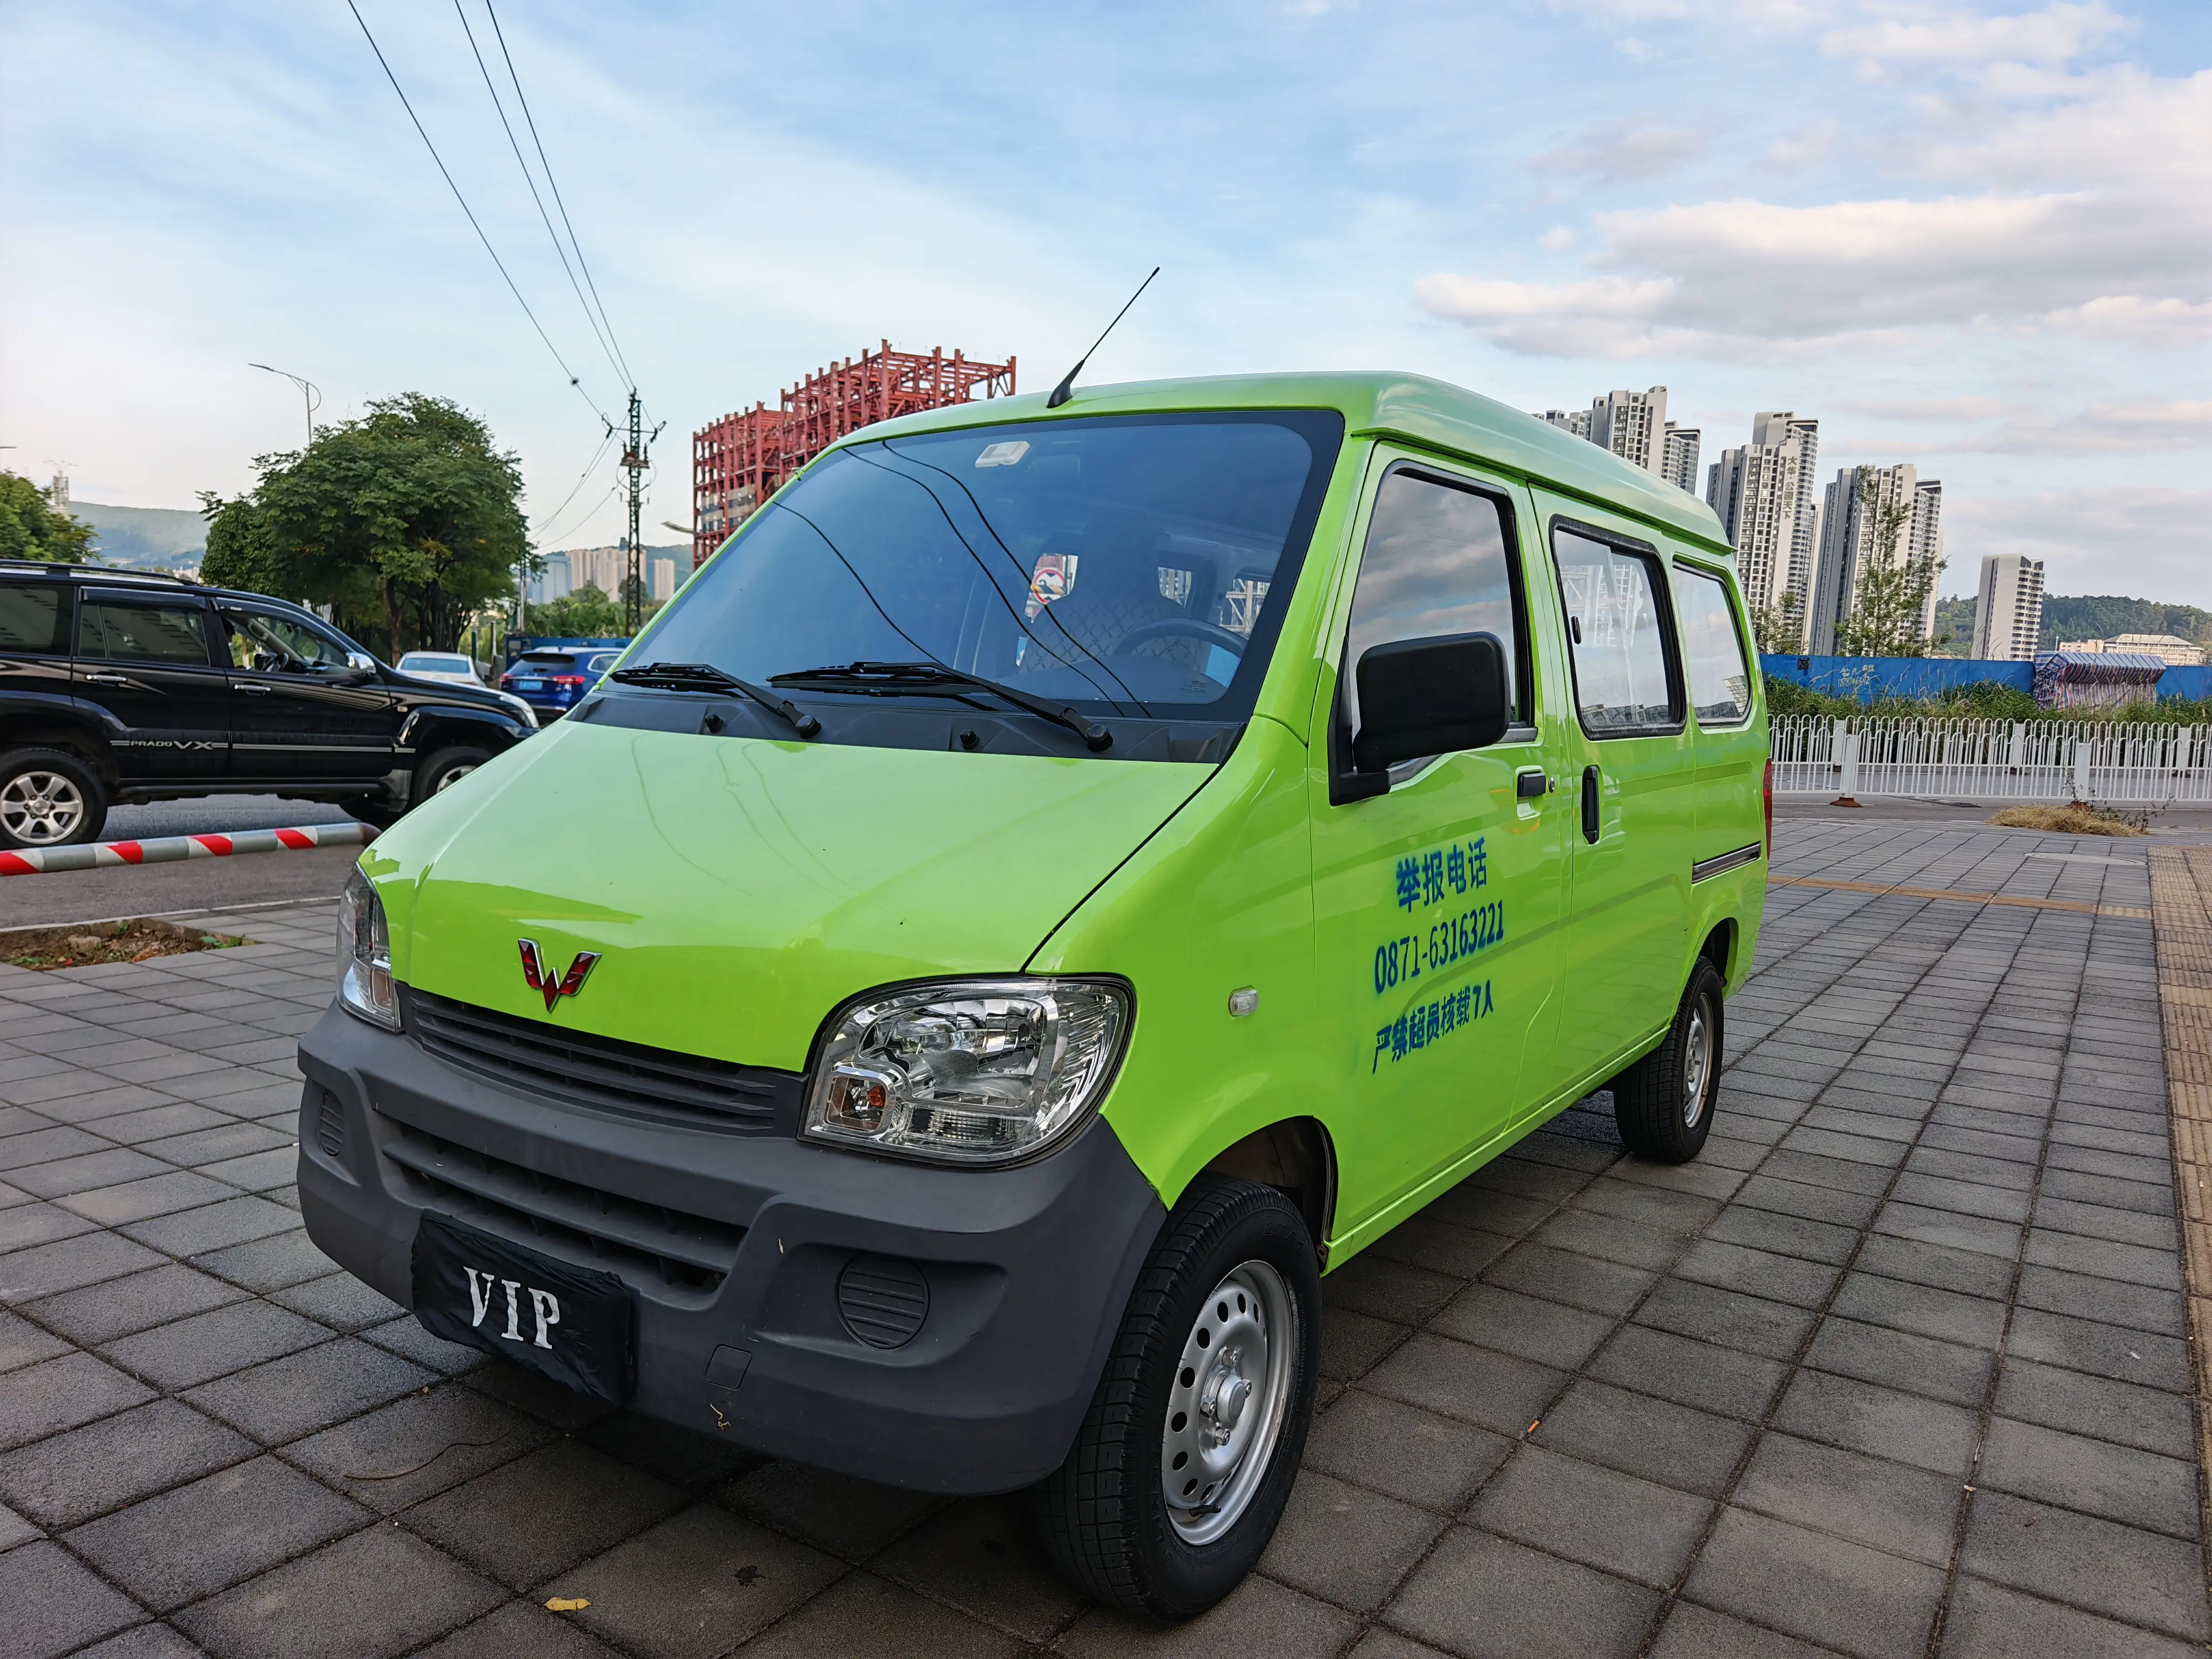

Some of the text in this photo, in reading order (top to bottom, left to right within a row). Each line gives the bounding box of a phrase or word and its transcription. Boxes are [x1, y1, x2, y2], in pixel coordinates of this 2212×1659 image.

[173, 741, 213, 750] VX
[1396, 837, 1487, 913] 举报电话
[1374, 900, 1504, 994] 0871-63163221
[1372, 979, 1494, 1075] 严禁超员核载7人
[463, 1266, 560, 1350] VIP
